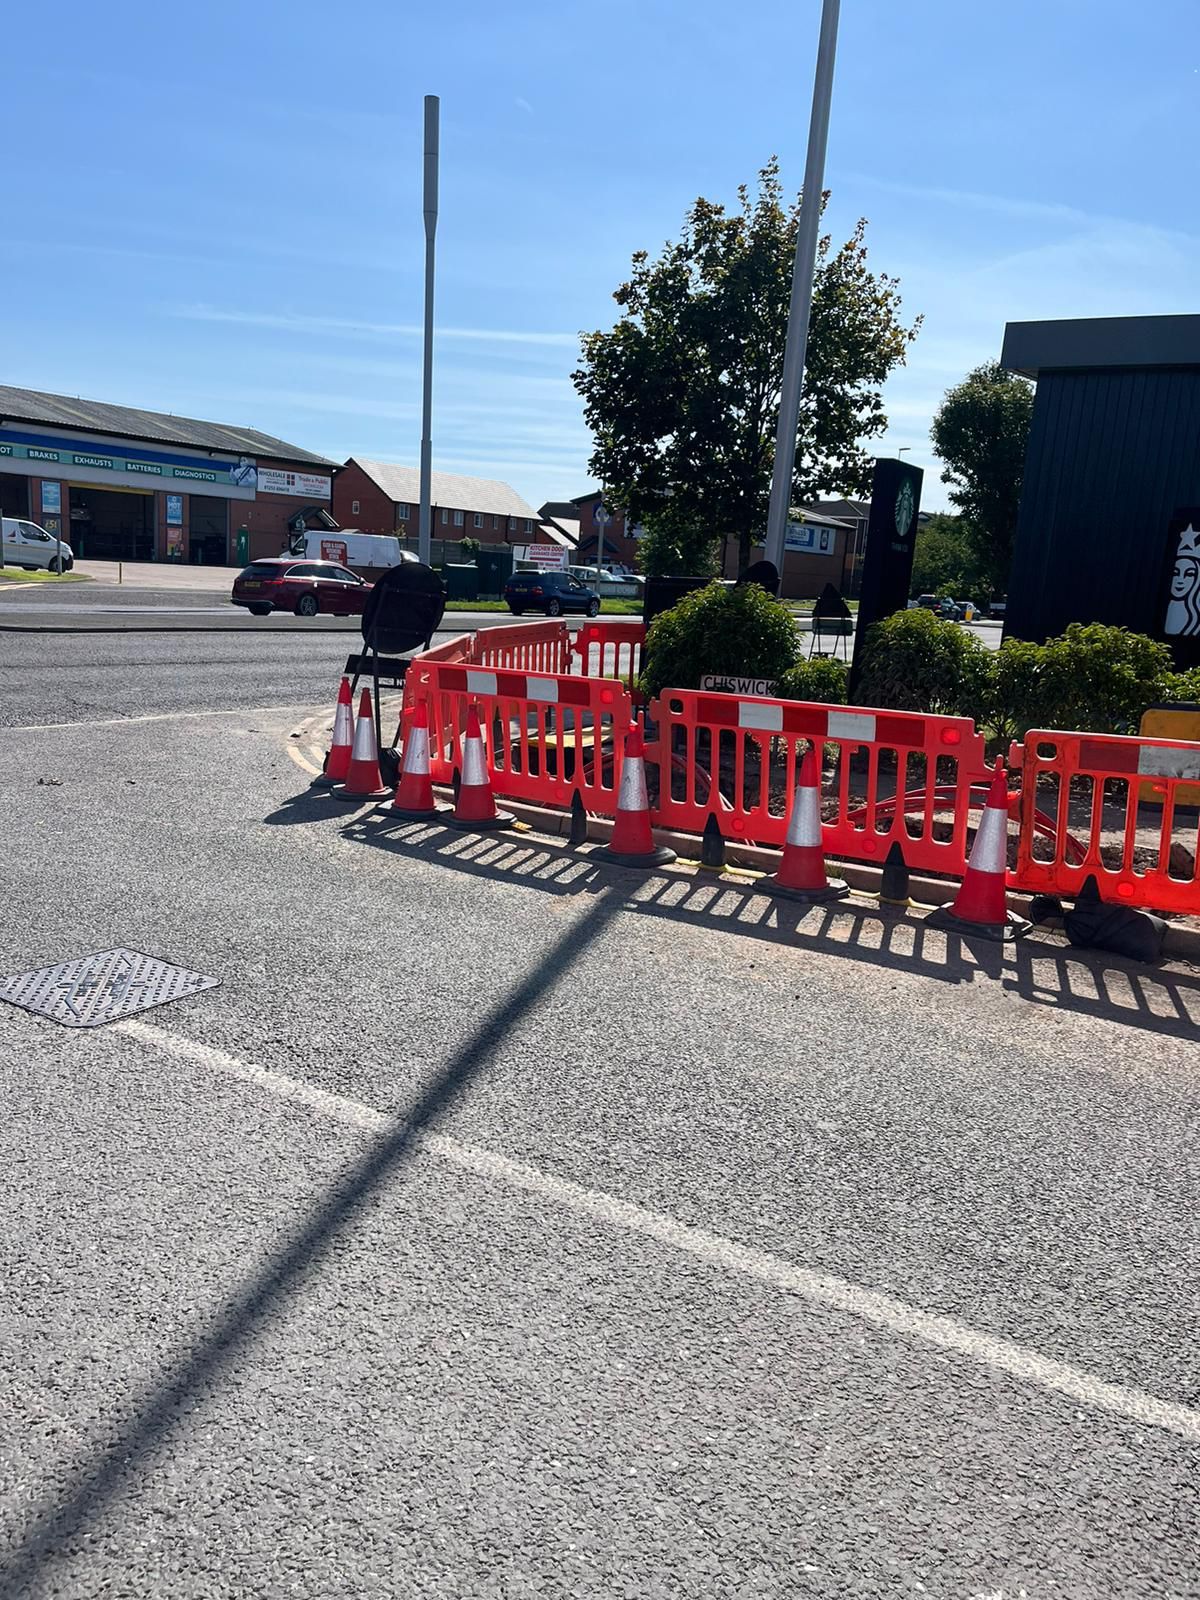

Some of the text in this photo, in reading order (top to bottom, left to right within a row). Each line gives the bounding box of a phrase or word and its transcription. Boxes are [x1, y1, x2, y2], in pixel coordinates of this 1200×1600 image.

[29, 449, 58, 460] BRAKES
[74, 456, 112, 467] EXHAUSTS
[127, 463, 161, 473] BATTERIES
[174, 469, 215, 480] DIAGNOSTICS
[258, 470, 286, 478] WHOLESALE
[704, 676, 776, 696] CHISWICK
